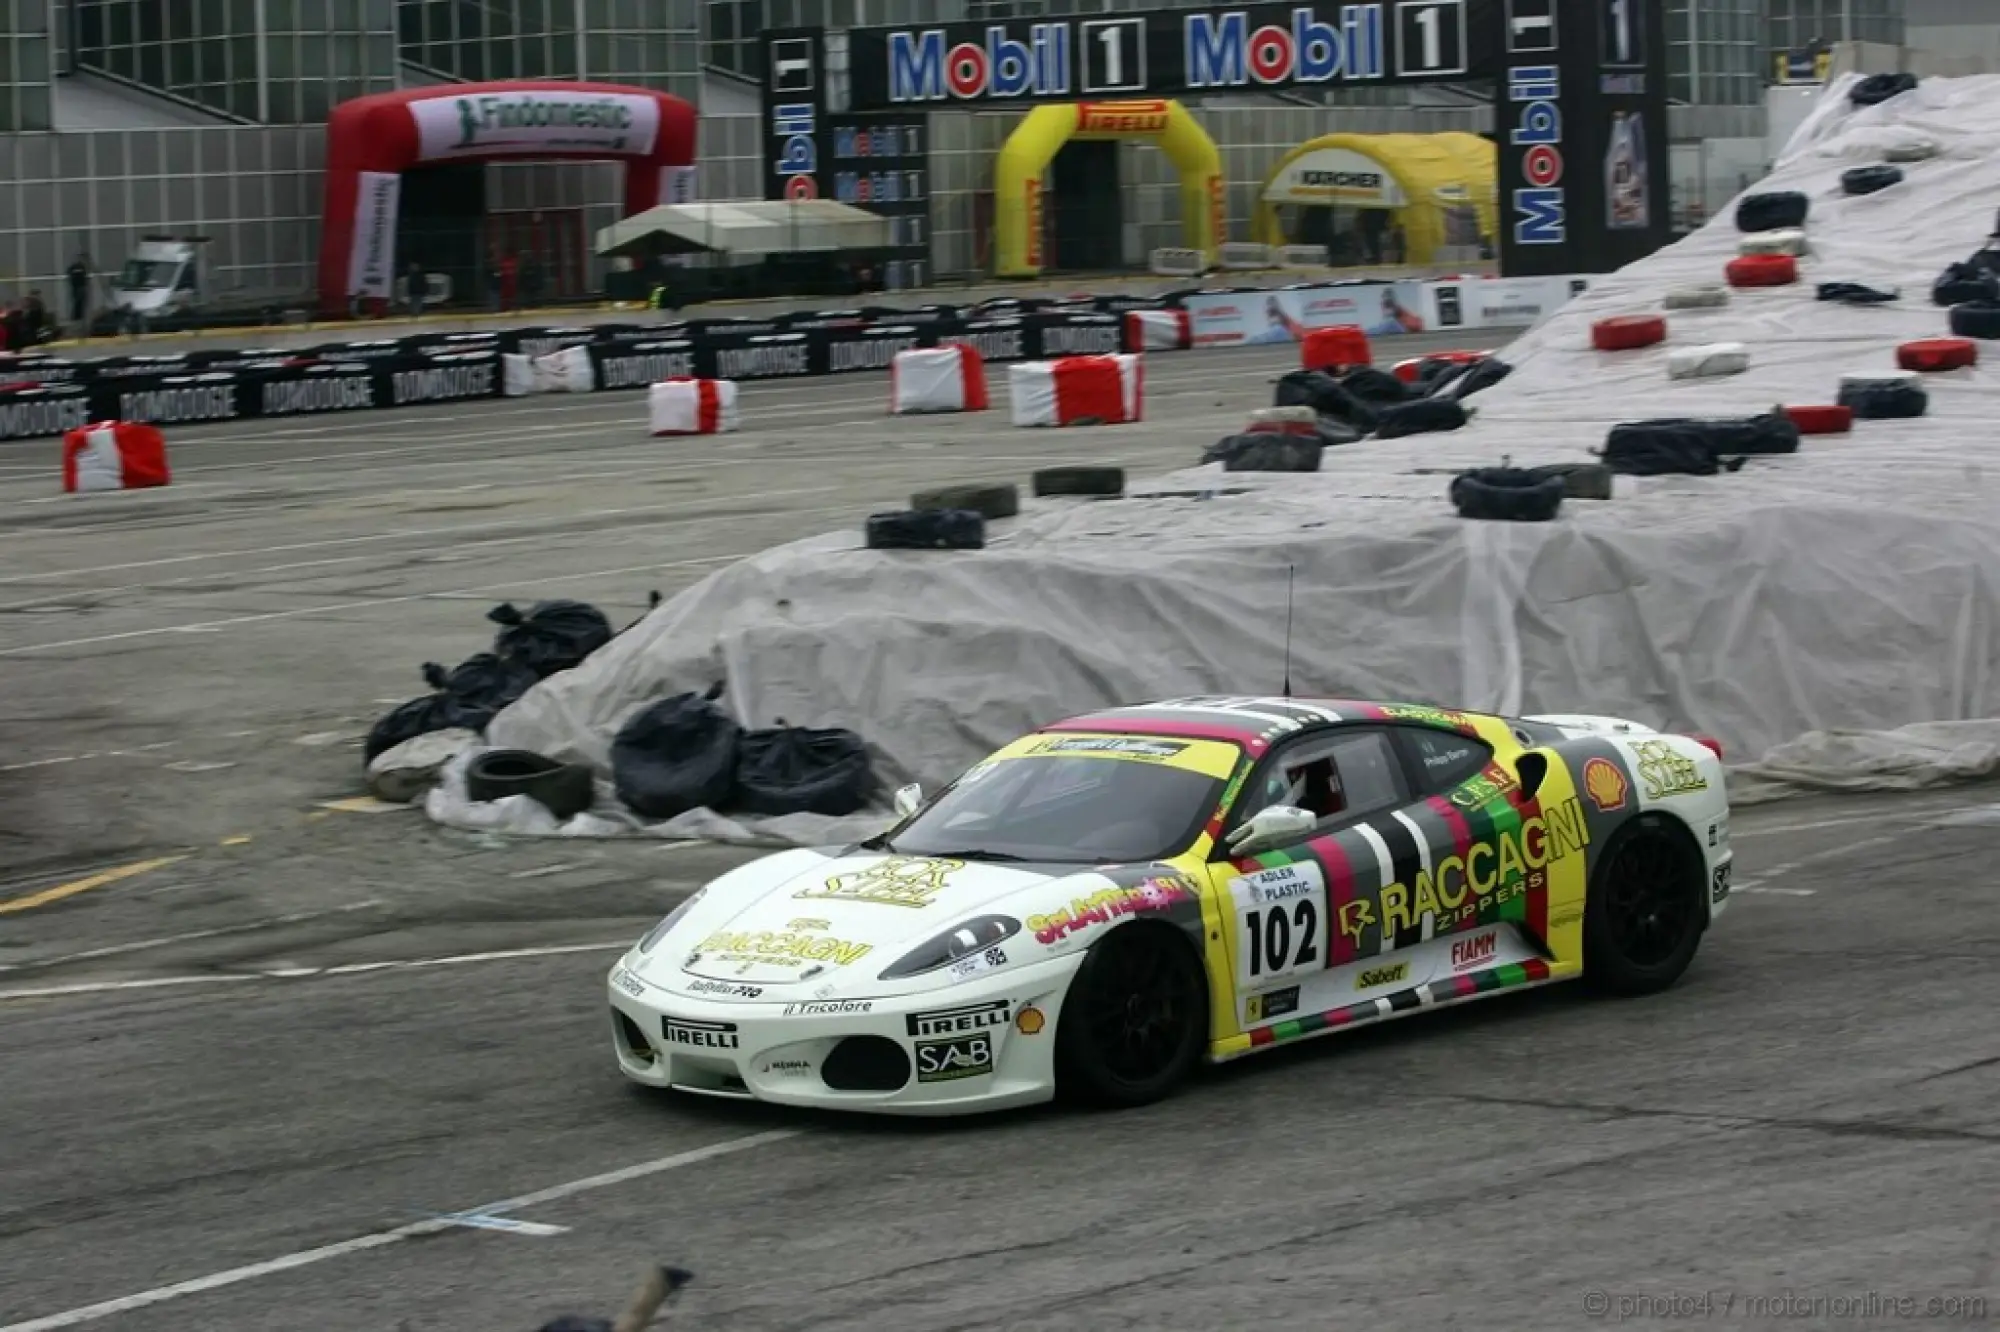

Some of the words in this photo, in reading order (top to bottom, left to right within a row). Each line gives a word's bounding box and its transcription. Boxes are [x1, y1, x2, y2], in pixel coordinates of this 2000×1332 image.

[887, 21, 1071, 102] Mobil
[1184, 3, 1385, 89] Mobil
[773, 102, 818, 201] obil
[1507, 64, 1567, 245] Mobil
[1260, 866, 1296, 884] ADLER
[1264, 880, 1311, 901] PLASTIC
[1379, 796, 1591, 940] RACCAGNI
[1435, 871, 1545, 932] ZIPPERS
[1245, 898, 1318, 976] 102
[1452, 931, 1497, 966] FIAMM
[660, 1014, 740, 1050] PIRELLI
[798, 1000, 874, 1015] Tricolore
[905, 999, 1012, 1037] PIRELLI
